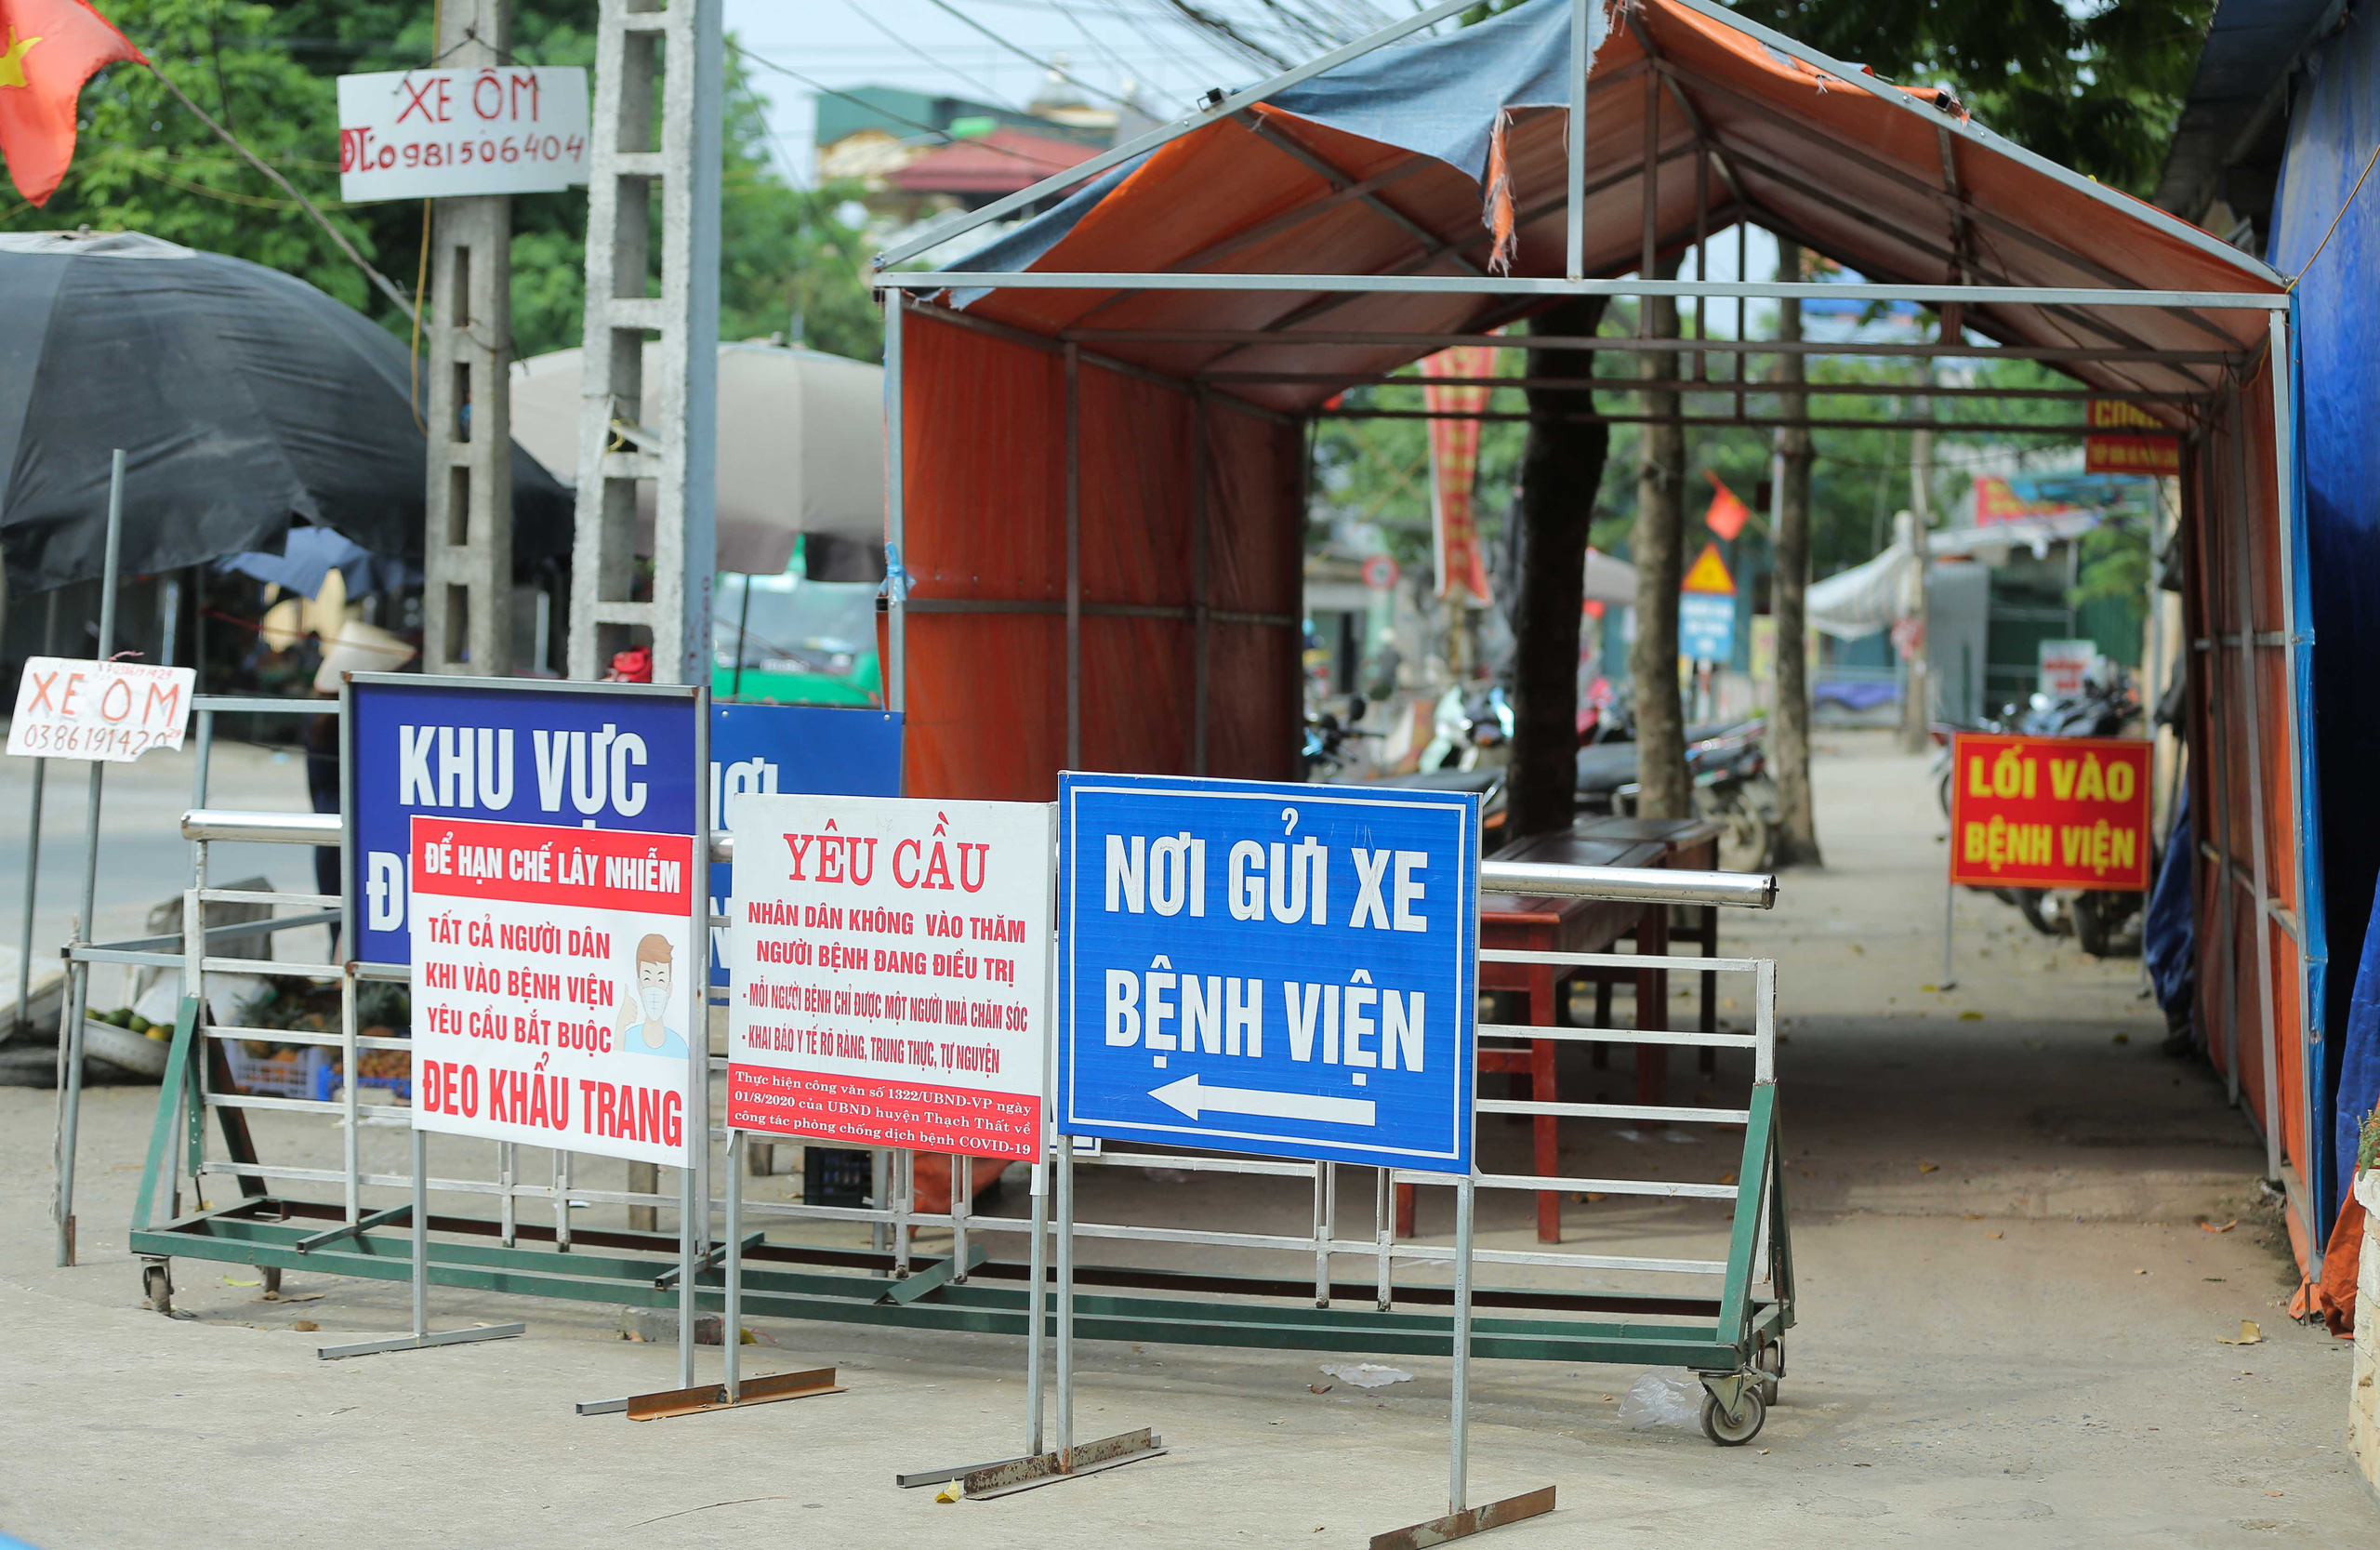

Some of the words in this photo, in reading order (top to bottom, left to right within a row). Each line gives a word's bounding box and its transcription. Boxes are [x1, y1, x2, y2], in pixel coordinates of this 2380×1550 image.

[396, 78, 452, 123] XE
[473, 68, 538, 122] ÔM
[28, 671, 85, 715] XE
[101, 679, 179, 727] OM
[399, 724, 514, 811] KHU
[533, 723, 648, 828] VỰC
[1968, 744, 2038, 801] LỐI
[2048, 751, 2135, 803] VÀO
[424, 830, 453, 876] ĐỂ
[458, 844, 502, 885] HẠN
[509, 841, 554, 882] CHẾ
[557, 846, 599, 886] LÂY
[605, 847, 681, 894] NHIỄM
[783, 818, 879, 886] YÊU
[892, 811, 990, 894] CẦU
[1104, 831, 1206, 918] NƠI
[1227, 807, 1329, 926] GỬI
[1348, 847, 1428, 933] XE
[1964, 814, 2053, 873] BỆNH
[2060, 818, 2136, 877] VIỆN
[428, 909, 462, 945] TẤT
[469, 913, 495, 948] CẢ
[500, 921, 561, 955] NGƯỜI
[568, 925, 610, 960] DÂN
[747, 898, 799, 927] NHÂN
[804, 902, 843, 930] DÂN
[849, 906, 914, 935] KHÔNG
[925, 909, 963, 939] VÀO
[970, 913, 1026, 944] THĂM
[426, 961, 456, 990] KHI
[463, 961, 501, 995] VÀO
[508, 966, 561, 1003] BỆNH
[567, 973, 614, 1011] VIỆN
[756, 938, 813, 966] NGƯỜI
[818, 941, 868, 974] BỆNH
[873, 949, 927, 975] ĐANG
[932, 947, 977, 978] ĐIỀU
[984, 957, 1014, 987] TRỊ
[427, 1003, 462, 1035] YÊU
[469, 1004, 507, 1040] CẦU
[514, 1009, 551, 1046] BẮT
[558, 1019, 612, 1057] BUỘC
[749, 974, 769, 1008] MỖI
[771, 981, 801, 1011] NGƯỜI
[804, 983, 831, 1017] BỆNH
[834, 983, 853, 1015] CHỈ
[853, 990, 881, 1023] ĐƯỢC
[884, 990, 907, 1026] MỘT
[909, 992, 943, 1024] NGƯỜI
[945, 996, 968, 1027] NHÀ
[971, 998, 1003, 1030] CHĂM
[1005, 1000, 1028, 1032] SÓC
[1104, 954, 1263, 1069] BỆNH
[1283, 968, 1426, 1087] VIỆN
[748, 1024, 772, 1050] KHAI
[774, 1023, 794, 1053] BÁO
[797, 1029, 803, 1053] Y
[806, 1023, 819, 1055] TẾ
[820, 1027, 834, 1057] RÕ
[837, 1029, 867, 1063] RÀNG,
[870, 1037, 905, 1064] TRUNG
[907, 1040, 937, 1071] THỰC,
[941, 1041, 955, 1074] TỰ
[956, 1042, 1000, 1079] NGUYỆN
[422, 1059, 479, 1119] ĐEO
[489, 1052, 570, 1132] KHẨU
[579, 1079, 682, 1148] TRANG
[734, 1071, 770, 1087] Thực
[772, 1074, 801, 1091] hiện
[804, 1080, 838, 1094] công
[840, 1083, 866, 1096] văn
[869, 1085, 886, 1099] số
[888, 1088, 994, 1110] 1322/UBND-VP
[997, 1102, 1032, 1116] ngày
[734, 1091, 796, 1108] 01/8/2020
[798, 1097, 824, 1111] của
[827, 1101, 872, 1117] UBND
[876, 1106, 920, 1123] huyện
[924, 1111, 971, 1129] Thạch
[974, 1118, 1011, 1133] Thất
[1014, 1121, 1032, 1135] về
[734, 1110, 767, 1125] công
[769, 1113, 790, 1126] tác
[793, 1117, 836, 1133] phòng
[839, 1122, 882, 1139] chống
[884, 1128, 916, 1143] dịch
[919, 1131, 956, 1146] bệnh
[959, 1135, 1032, 1156] COVID-19
